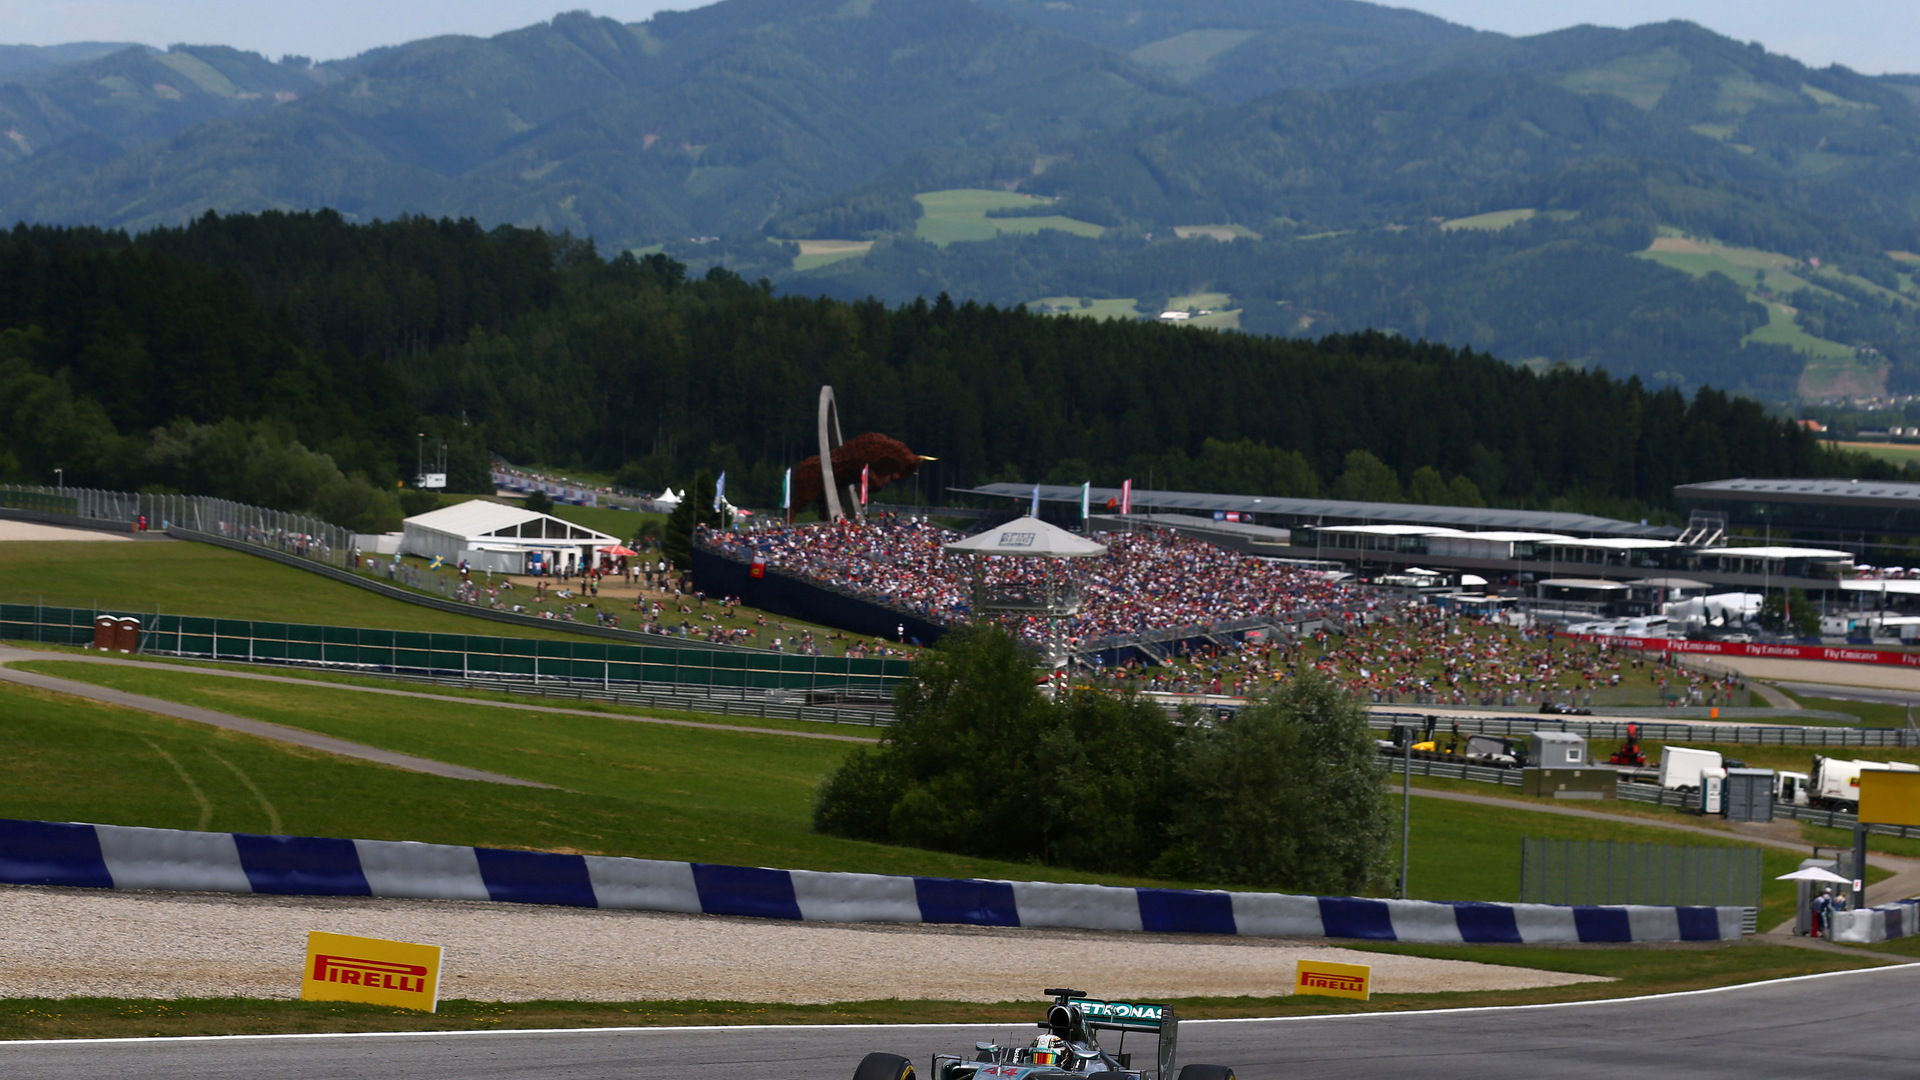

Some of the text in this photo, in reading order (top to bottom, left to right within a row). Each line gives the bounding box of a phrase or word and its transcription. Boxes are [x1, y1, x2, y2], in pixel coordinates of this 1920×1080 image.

[1667, 640, 1721, 652] Fly Emirates
[1746, 644, 1799, 656] Fly Emirates
[1824, 649, 1878, 660] Fly Emirates
[1902, 654, 1918, 665] Fly
[313, 954, 427, 992] PIRELLI
[1301, 972, 1364, 991] PIRELLI
[982, 1067, 1018, 1077] 44
